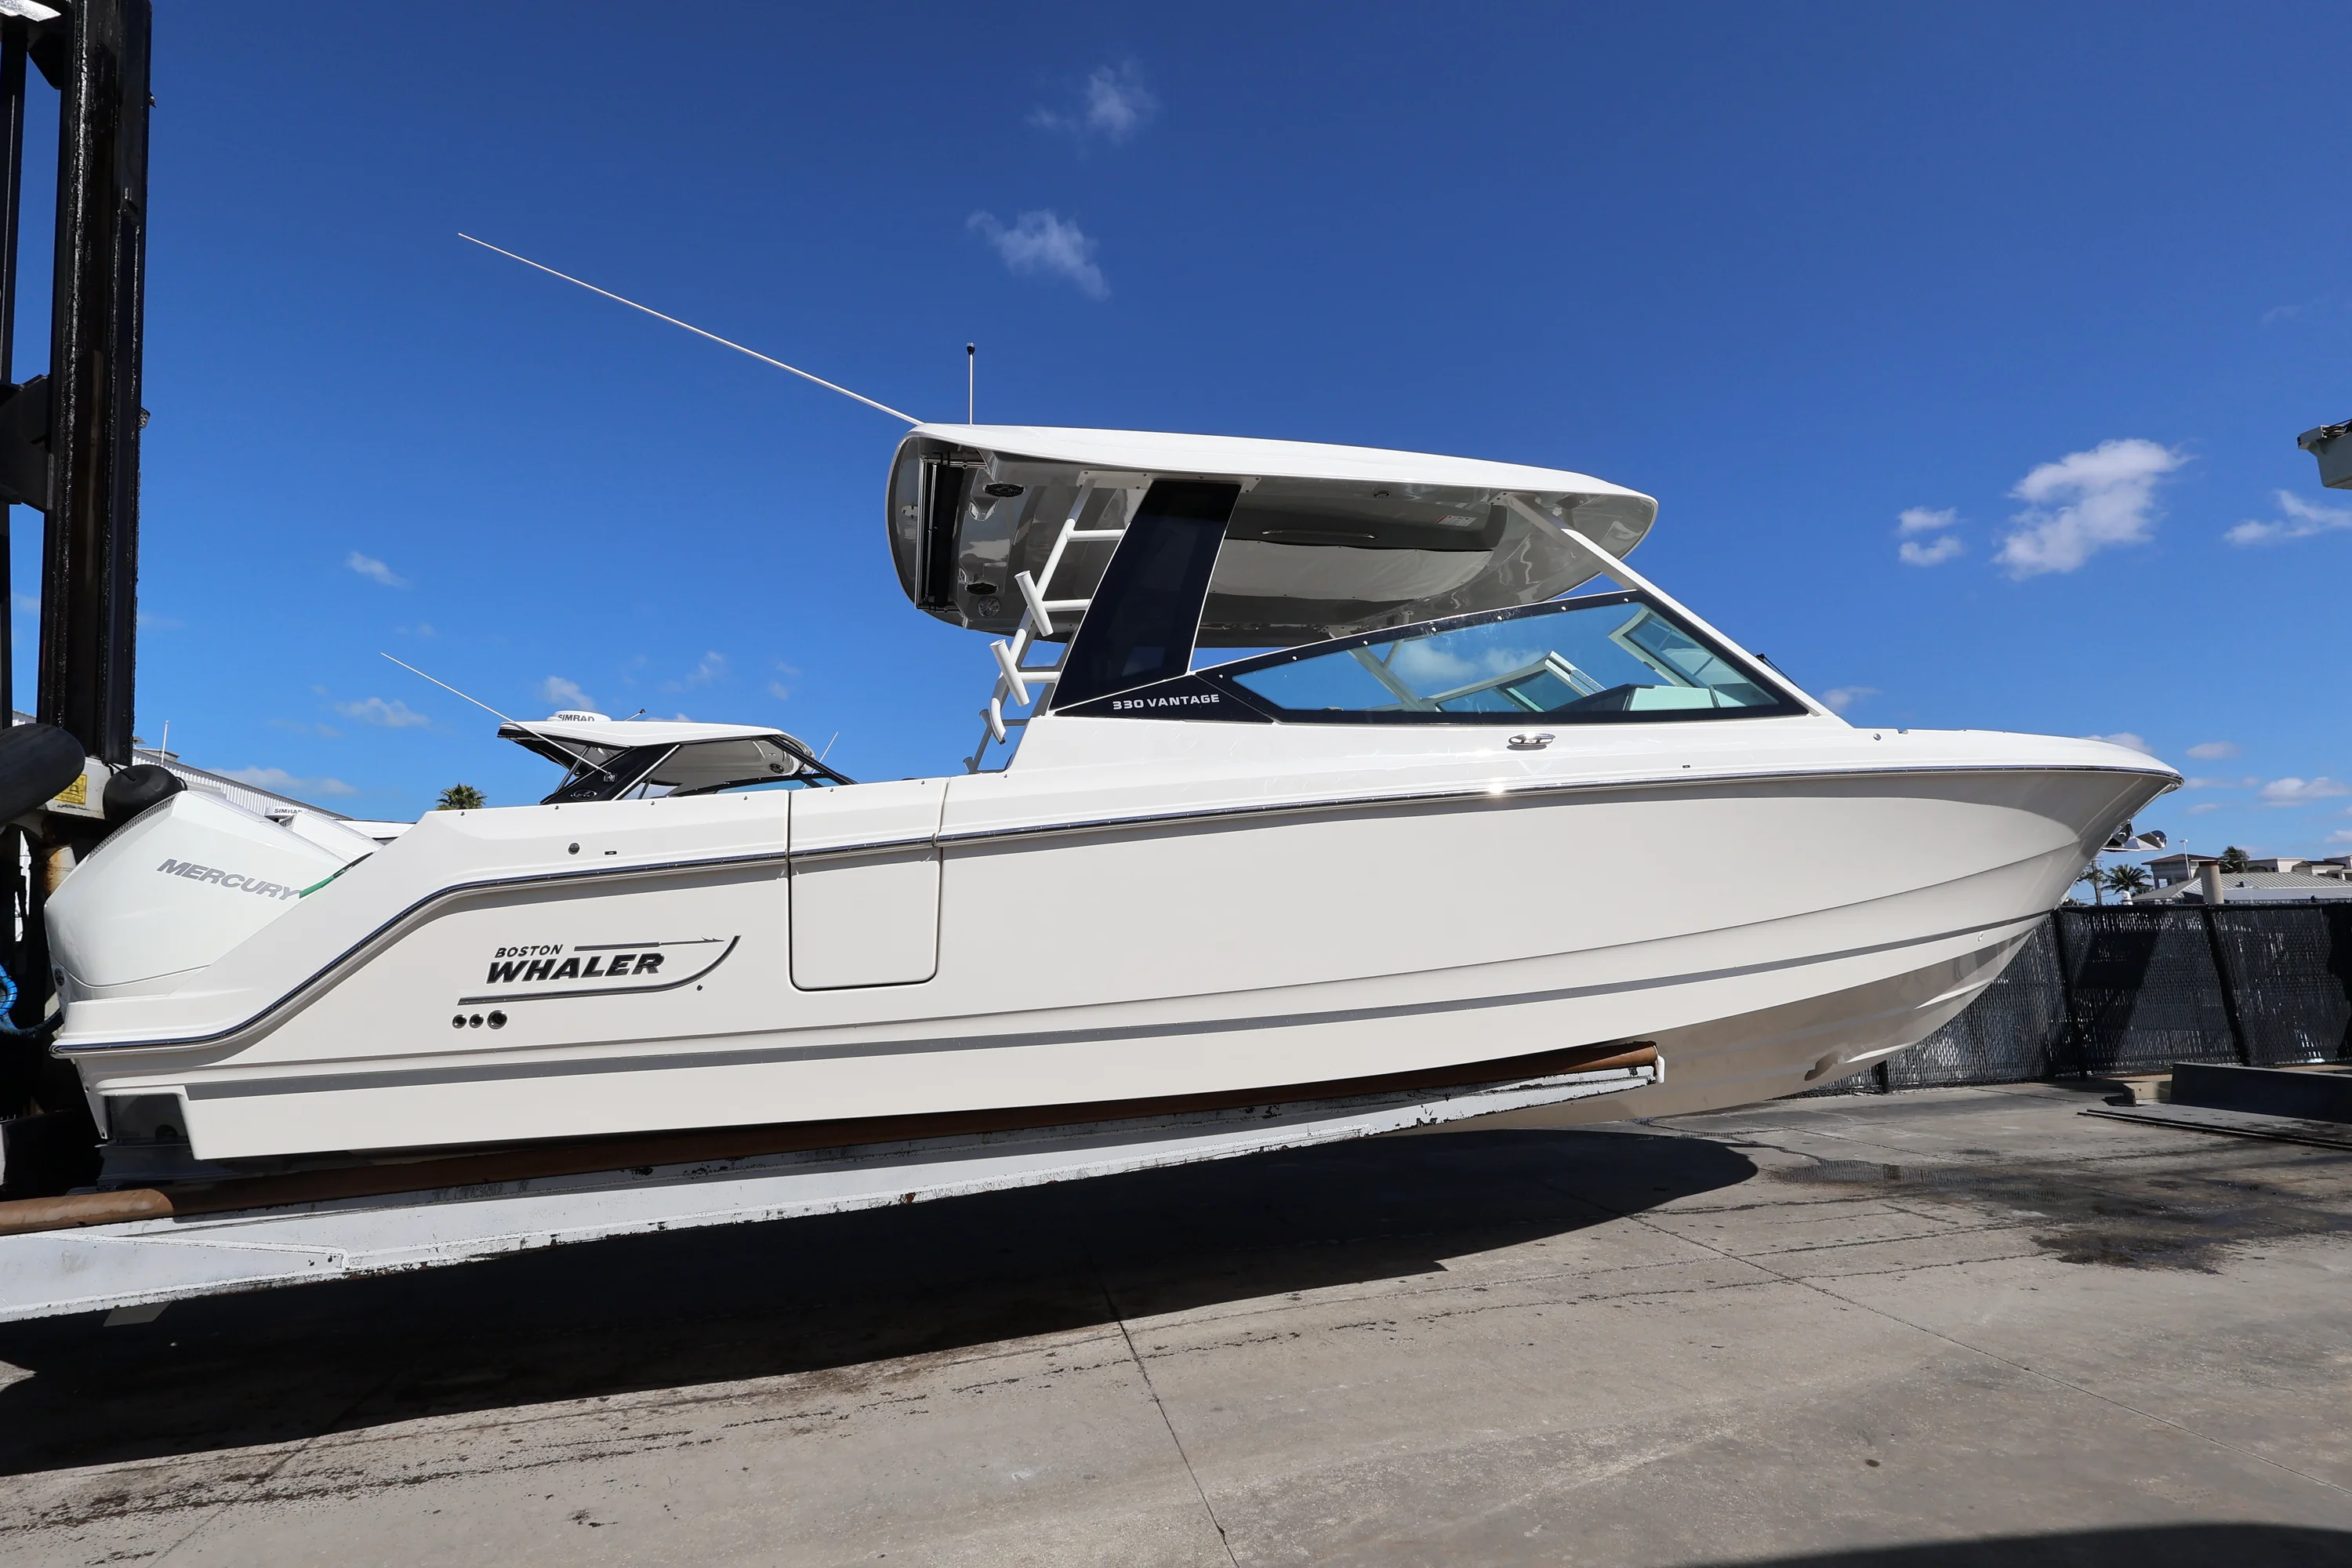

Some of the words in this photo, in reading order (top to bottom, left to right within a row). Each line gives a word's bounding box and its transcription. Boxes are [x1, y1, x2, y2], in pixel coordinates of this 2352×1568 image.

[1112, 699, 1145, 710] 330
[1146, 694, 1220, 708] VANTAGE
[557, 713, 595, 722] SIMRAD
[156, 858, 301, 901] MERCURY
[494, 943, 564, 959] BOSTON
[486, 953, 665, 984] WHALER
